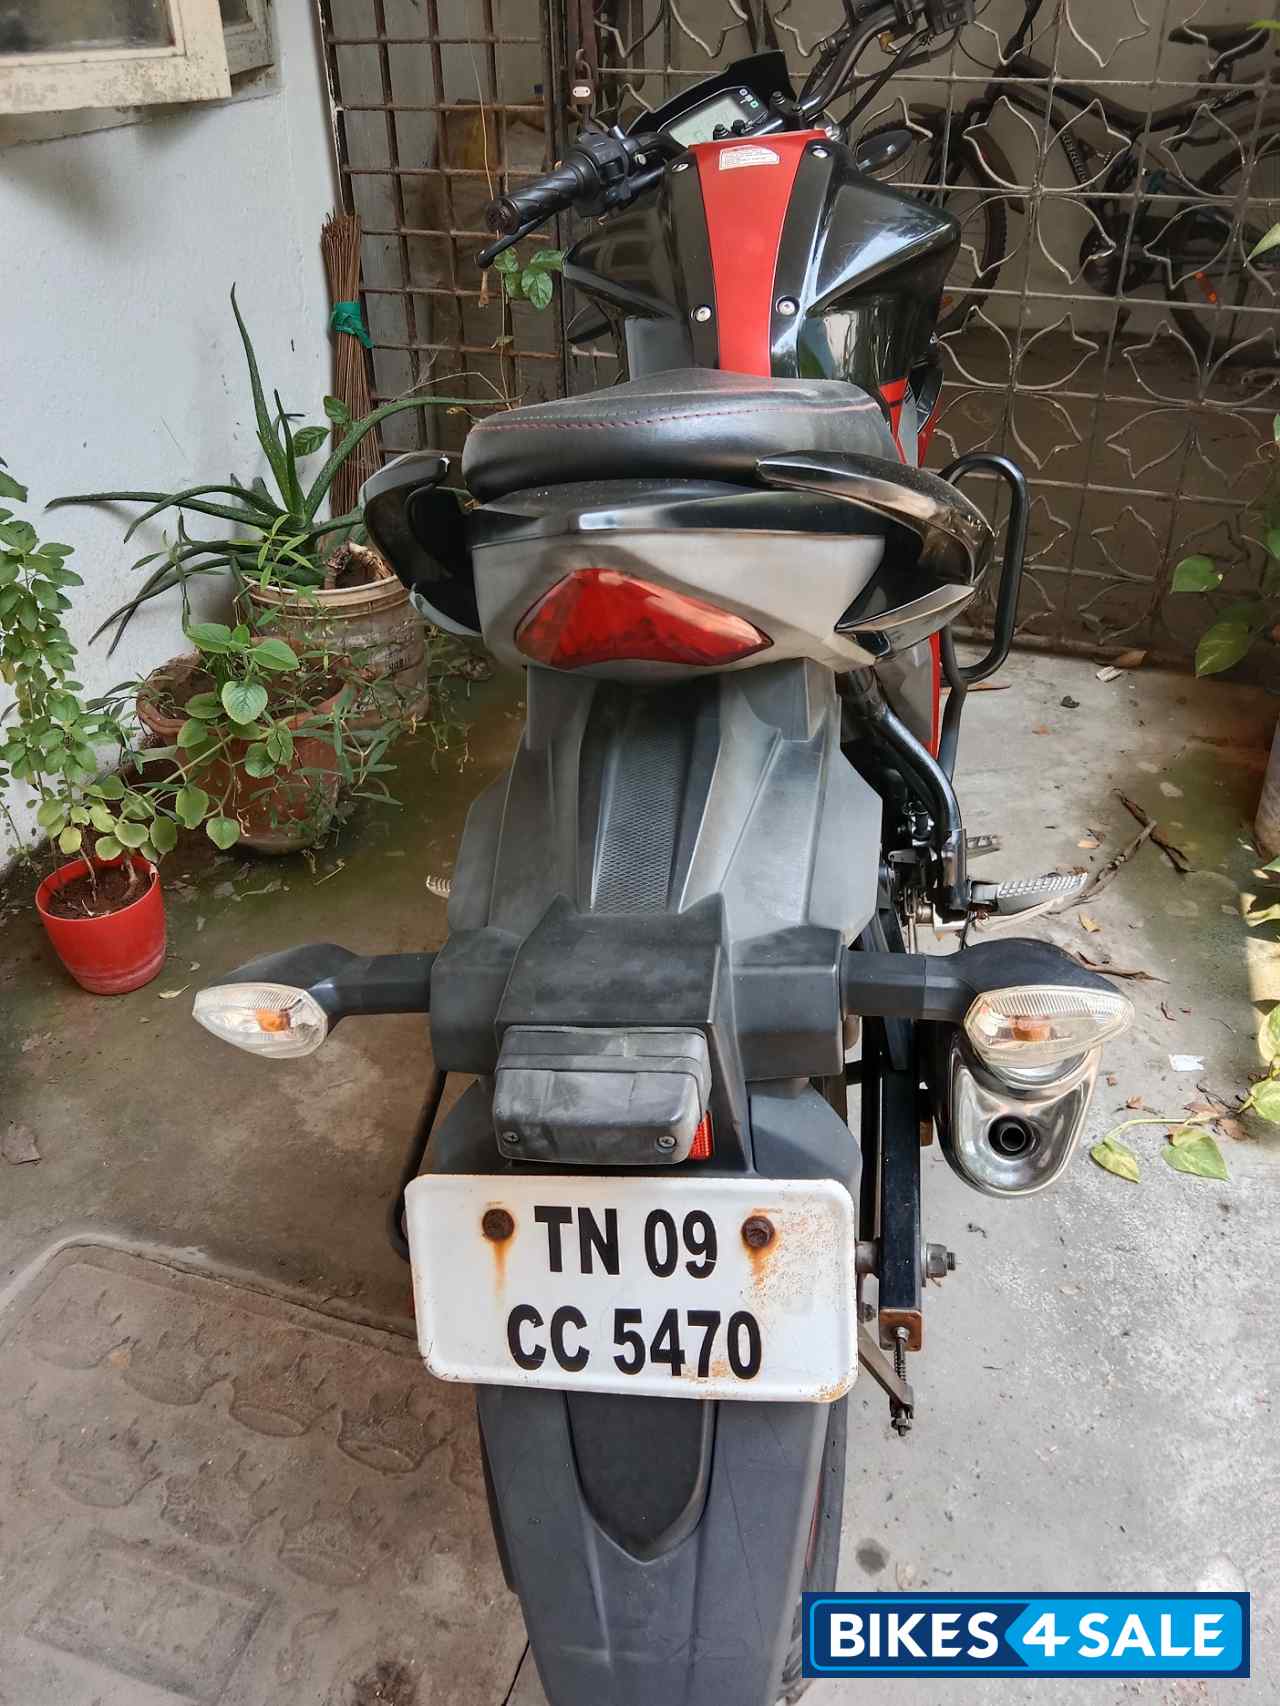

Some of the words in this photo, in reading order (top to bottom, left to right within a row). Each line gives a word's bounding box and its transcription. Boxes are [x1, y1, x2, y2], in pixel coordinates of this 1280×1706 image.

[534, 1205, 620, 1276] TN
[644, 1208, 718, 1279] 09
[507, 1303, 590, 1372] CC
[613, 1308, 762, 1380] 5470
